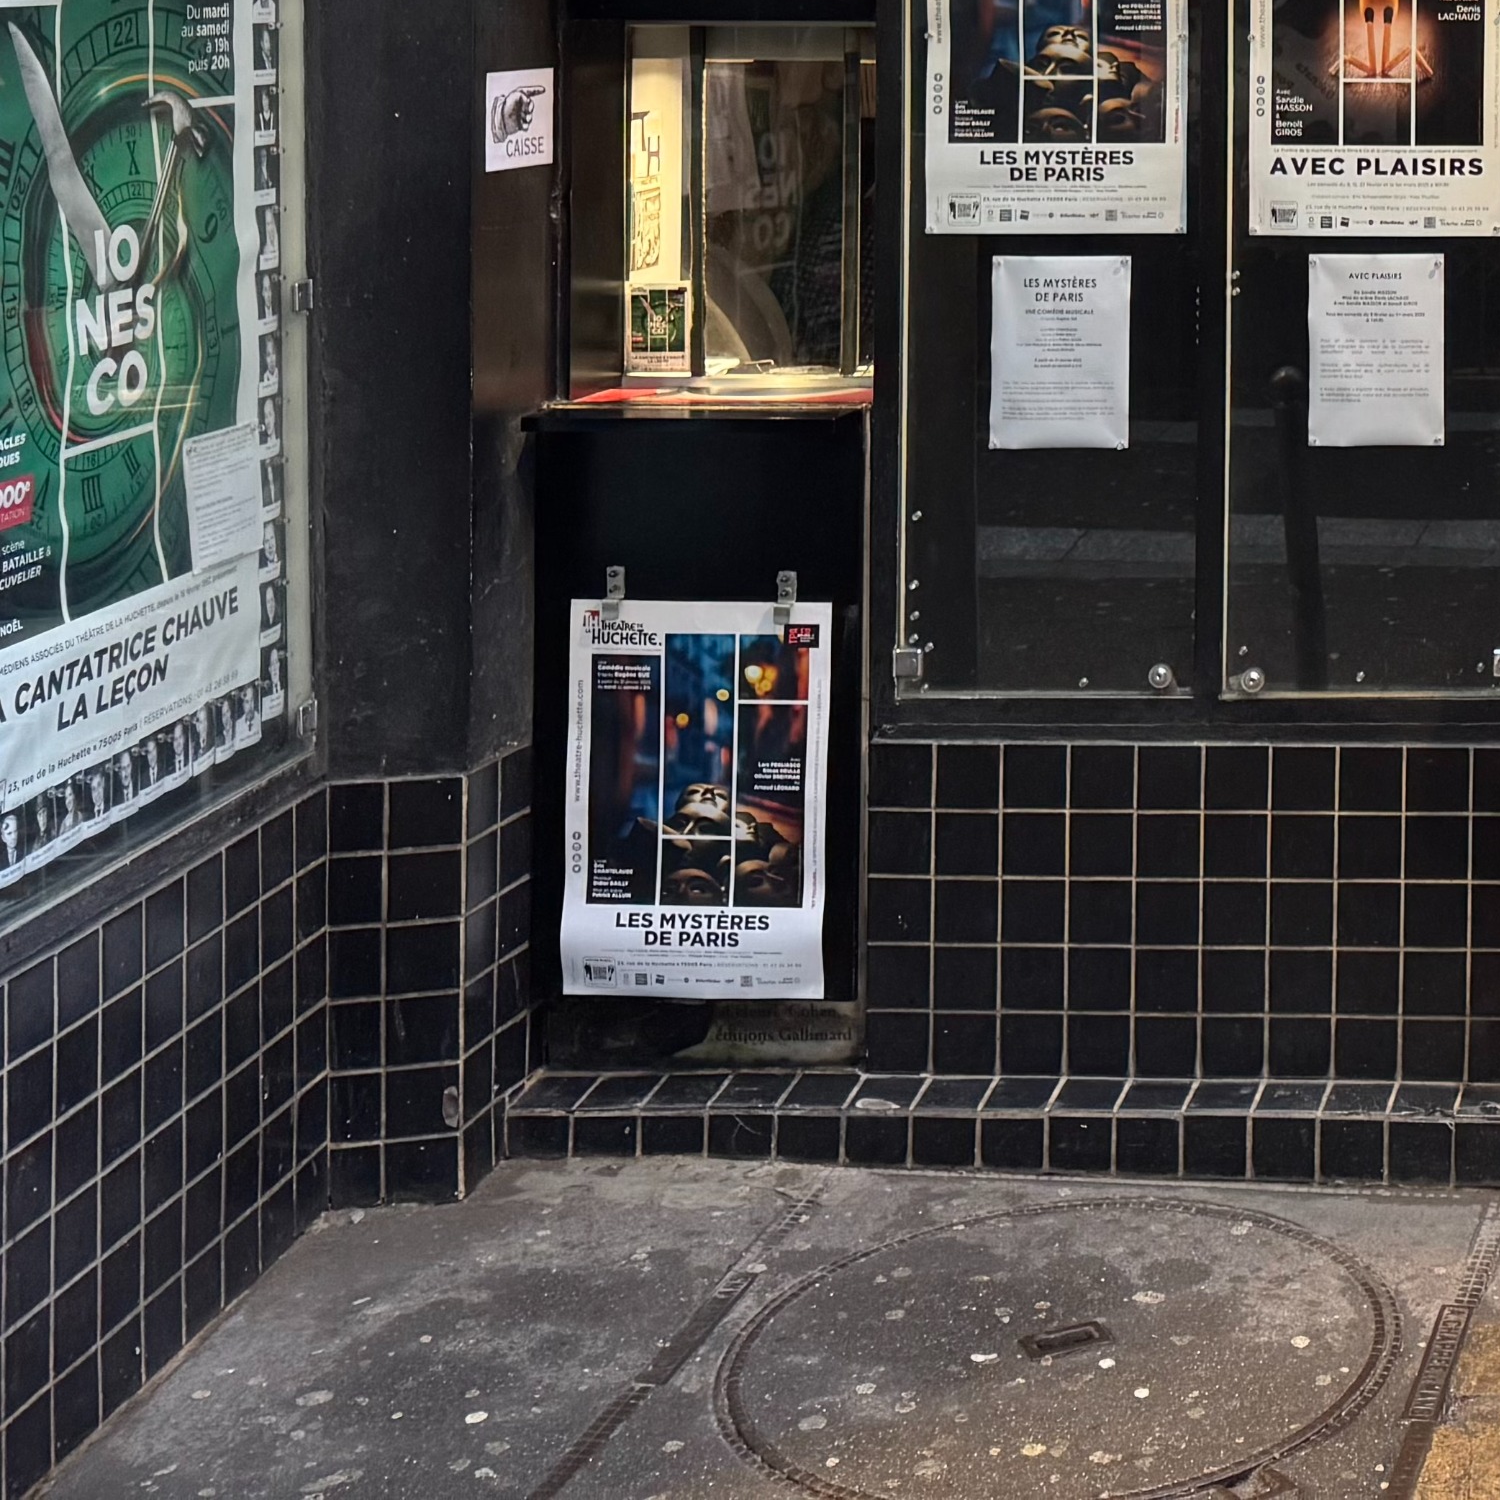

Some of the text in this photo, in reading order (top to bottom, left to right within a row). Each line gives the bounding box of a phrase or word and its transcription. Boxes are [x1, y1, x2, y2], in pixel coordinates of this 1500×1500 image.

[187, 2, 229, 19] Du mardi
[1438, 13, 1480, 21] LACHAUD
[1456, 5, 1480, 13] Denis
[181, 20, 229, 37] au samedi
[214, 37, 229, 52] 19h
[188, 54, 230, 74] puis 20h
[506, 136, 544, 158] CAISSE
[980, 147, 1134, 165] LES MYSTÈRES
[1010, 167, 1105, 181] DE PARIS
[1270, 157, 1484, 176] AVEC PLAISIRS
[1023, 276, 1097, 288] LES MYSTÈRES
[1348, 272, 1402, 280] AVEC PLAISIRS
[1035, 293, 1084, 302] DE PARIS
[2, 550, 44, 573] BATAILLE
[30, 643, 64, 663] ASSOCIÉS
[65, 637, 75, 649] DU
[76, 626, 105, 646] THÉÂTRE
[106, 623, 114, 634] DE
[115, 619, 123, 629] LA
[15, 586, 239, 716] CANTATRICE CHAUVE
[57, 654, 169, 732] LA LEÇON
[21, 773, 34, 788] rue
[36, 767, 47, 781] de
[48, 762, 55, 774] la
[57, 746, 91, 770] Huchette
[98, 730, 122, 749] 75005
[615, 910, 770, 930] LES MYSTÈRES
[644, 931, 739, 947] DE PARIS
